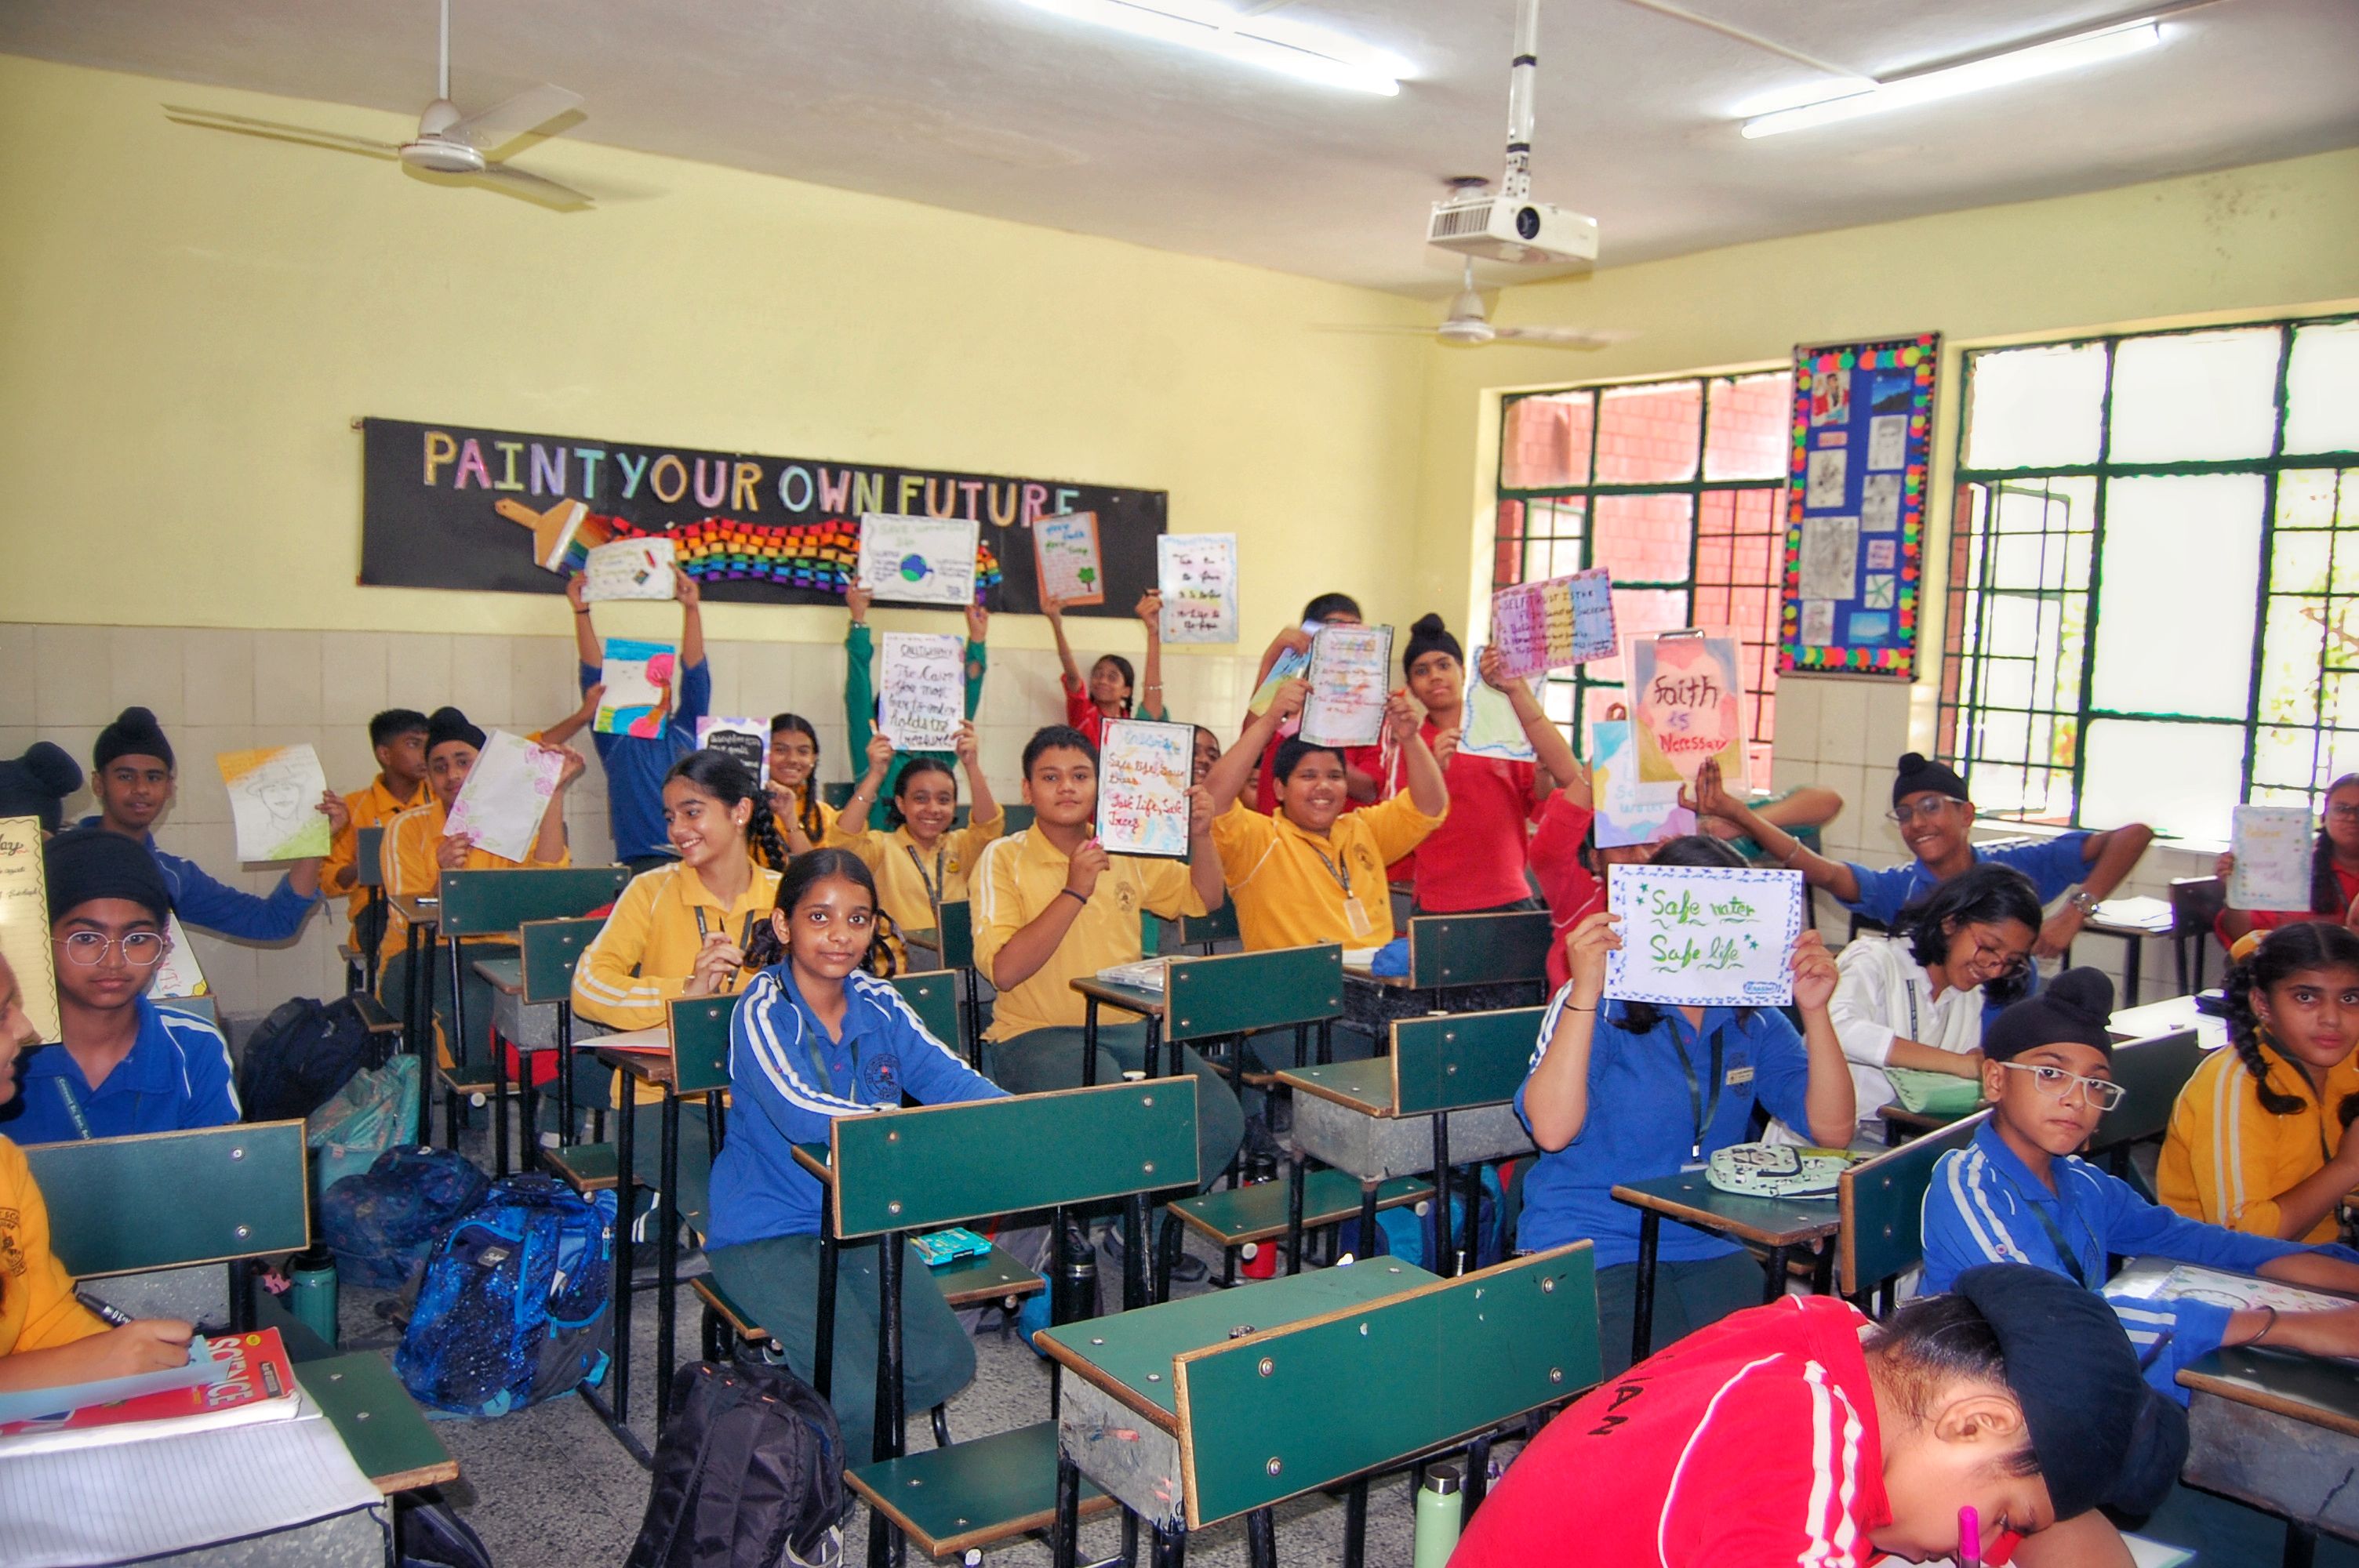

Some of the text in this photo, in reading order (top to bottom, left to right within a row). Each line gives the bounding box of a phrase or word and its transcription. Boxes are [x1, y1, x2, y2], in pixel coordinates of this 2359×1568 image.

[423, 430, 606, 499] PAINT
[616, 452, 763, 512] YOUR
[778, 465, 885, 515] OWN
[1652, 888, 1756, 925] Safe water
[1650, 934, 1740, 970] Safe life
